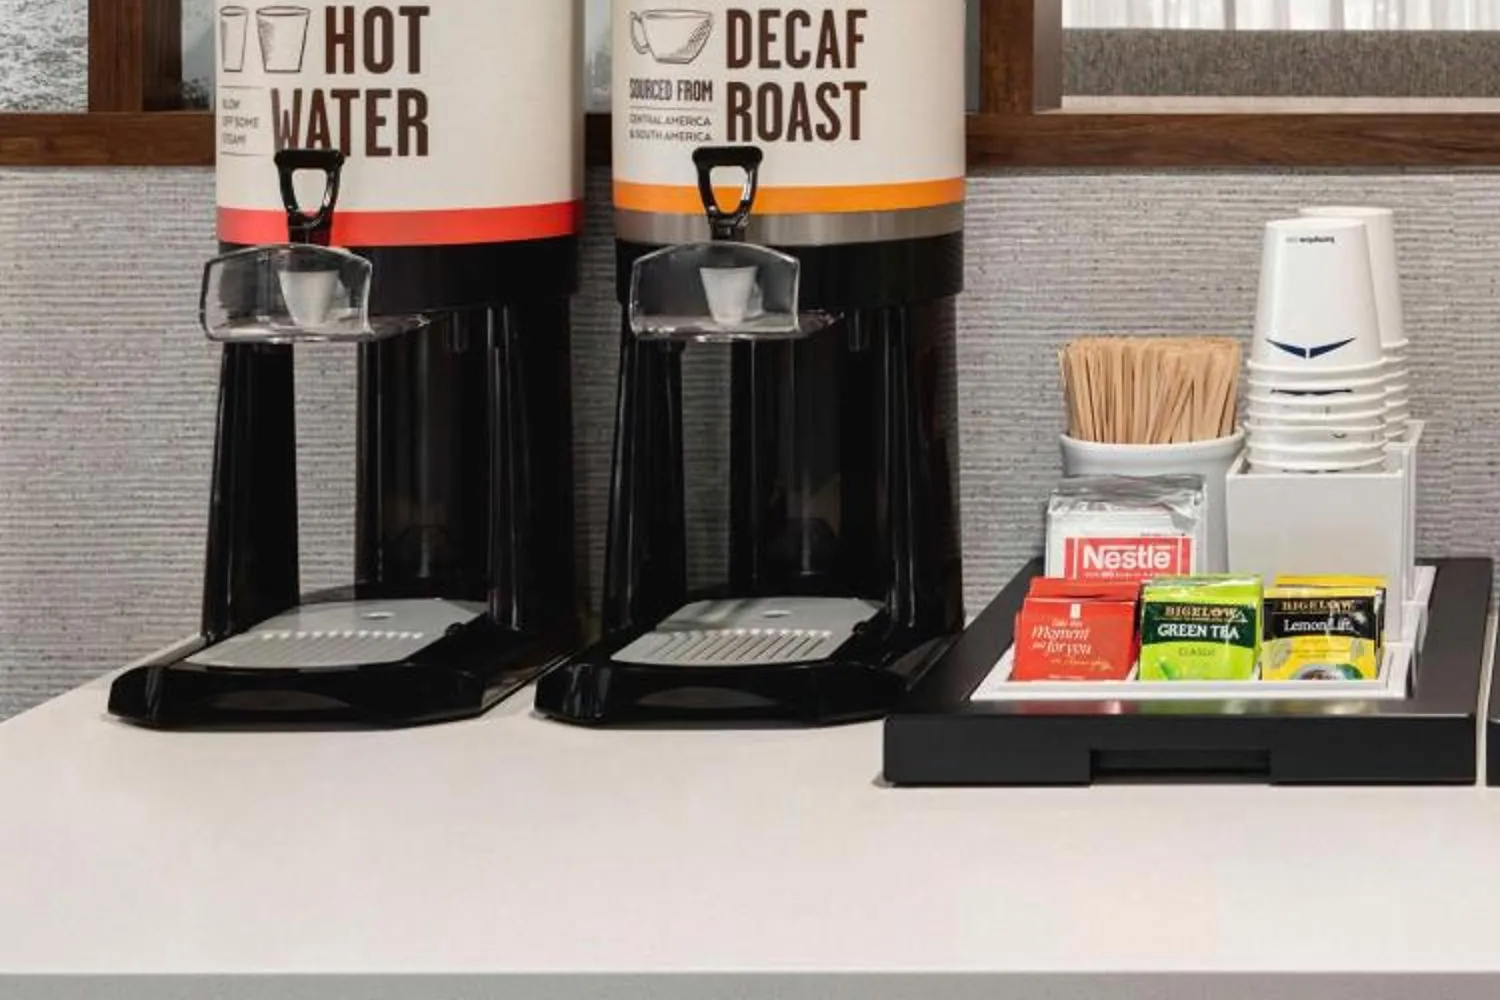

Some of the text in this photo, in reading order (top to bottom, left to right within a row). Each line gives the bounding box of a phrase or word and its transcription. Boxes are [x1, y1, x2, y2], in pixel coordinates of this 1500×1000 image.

[325, 5, 430, 75] HOT
[726, 8, 867, 69] DECAF
[629, 78, 713, 102] SOURCED FROM
[664, 114, 712, 127] AMERICA
[726, 81, 867, 142] ROAST
[271, 88, 429, 157] WATER
[664, 130, 712, 142] AMERICA
[1165, 605, 1236, 618] BIGELOW
[1157, 622, 1240, 640] GREEN TEA
[1283, 618, 1327, 632] Lemon
